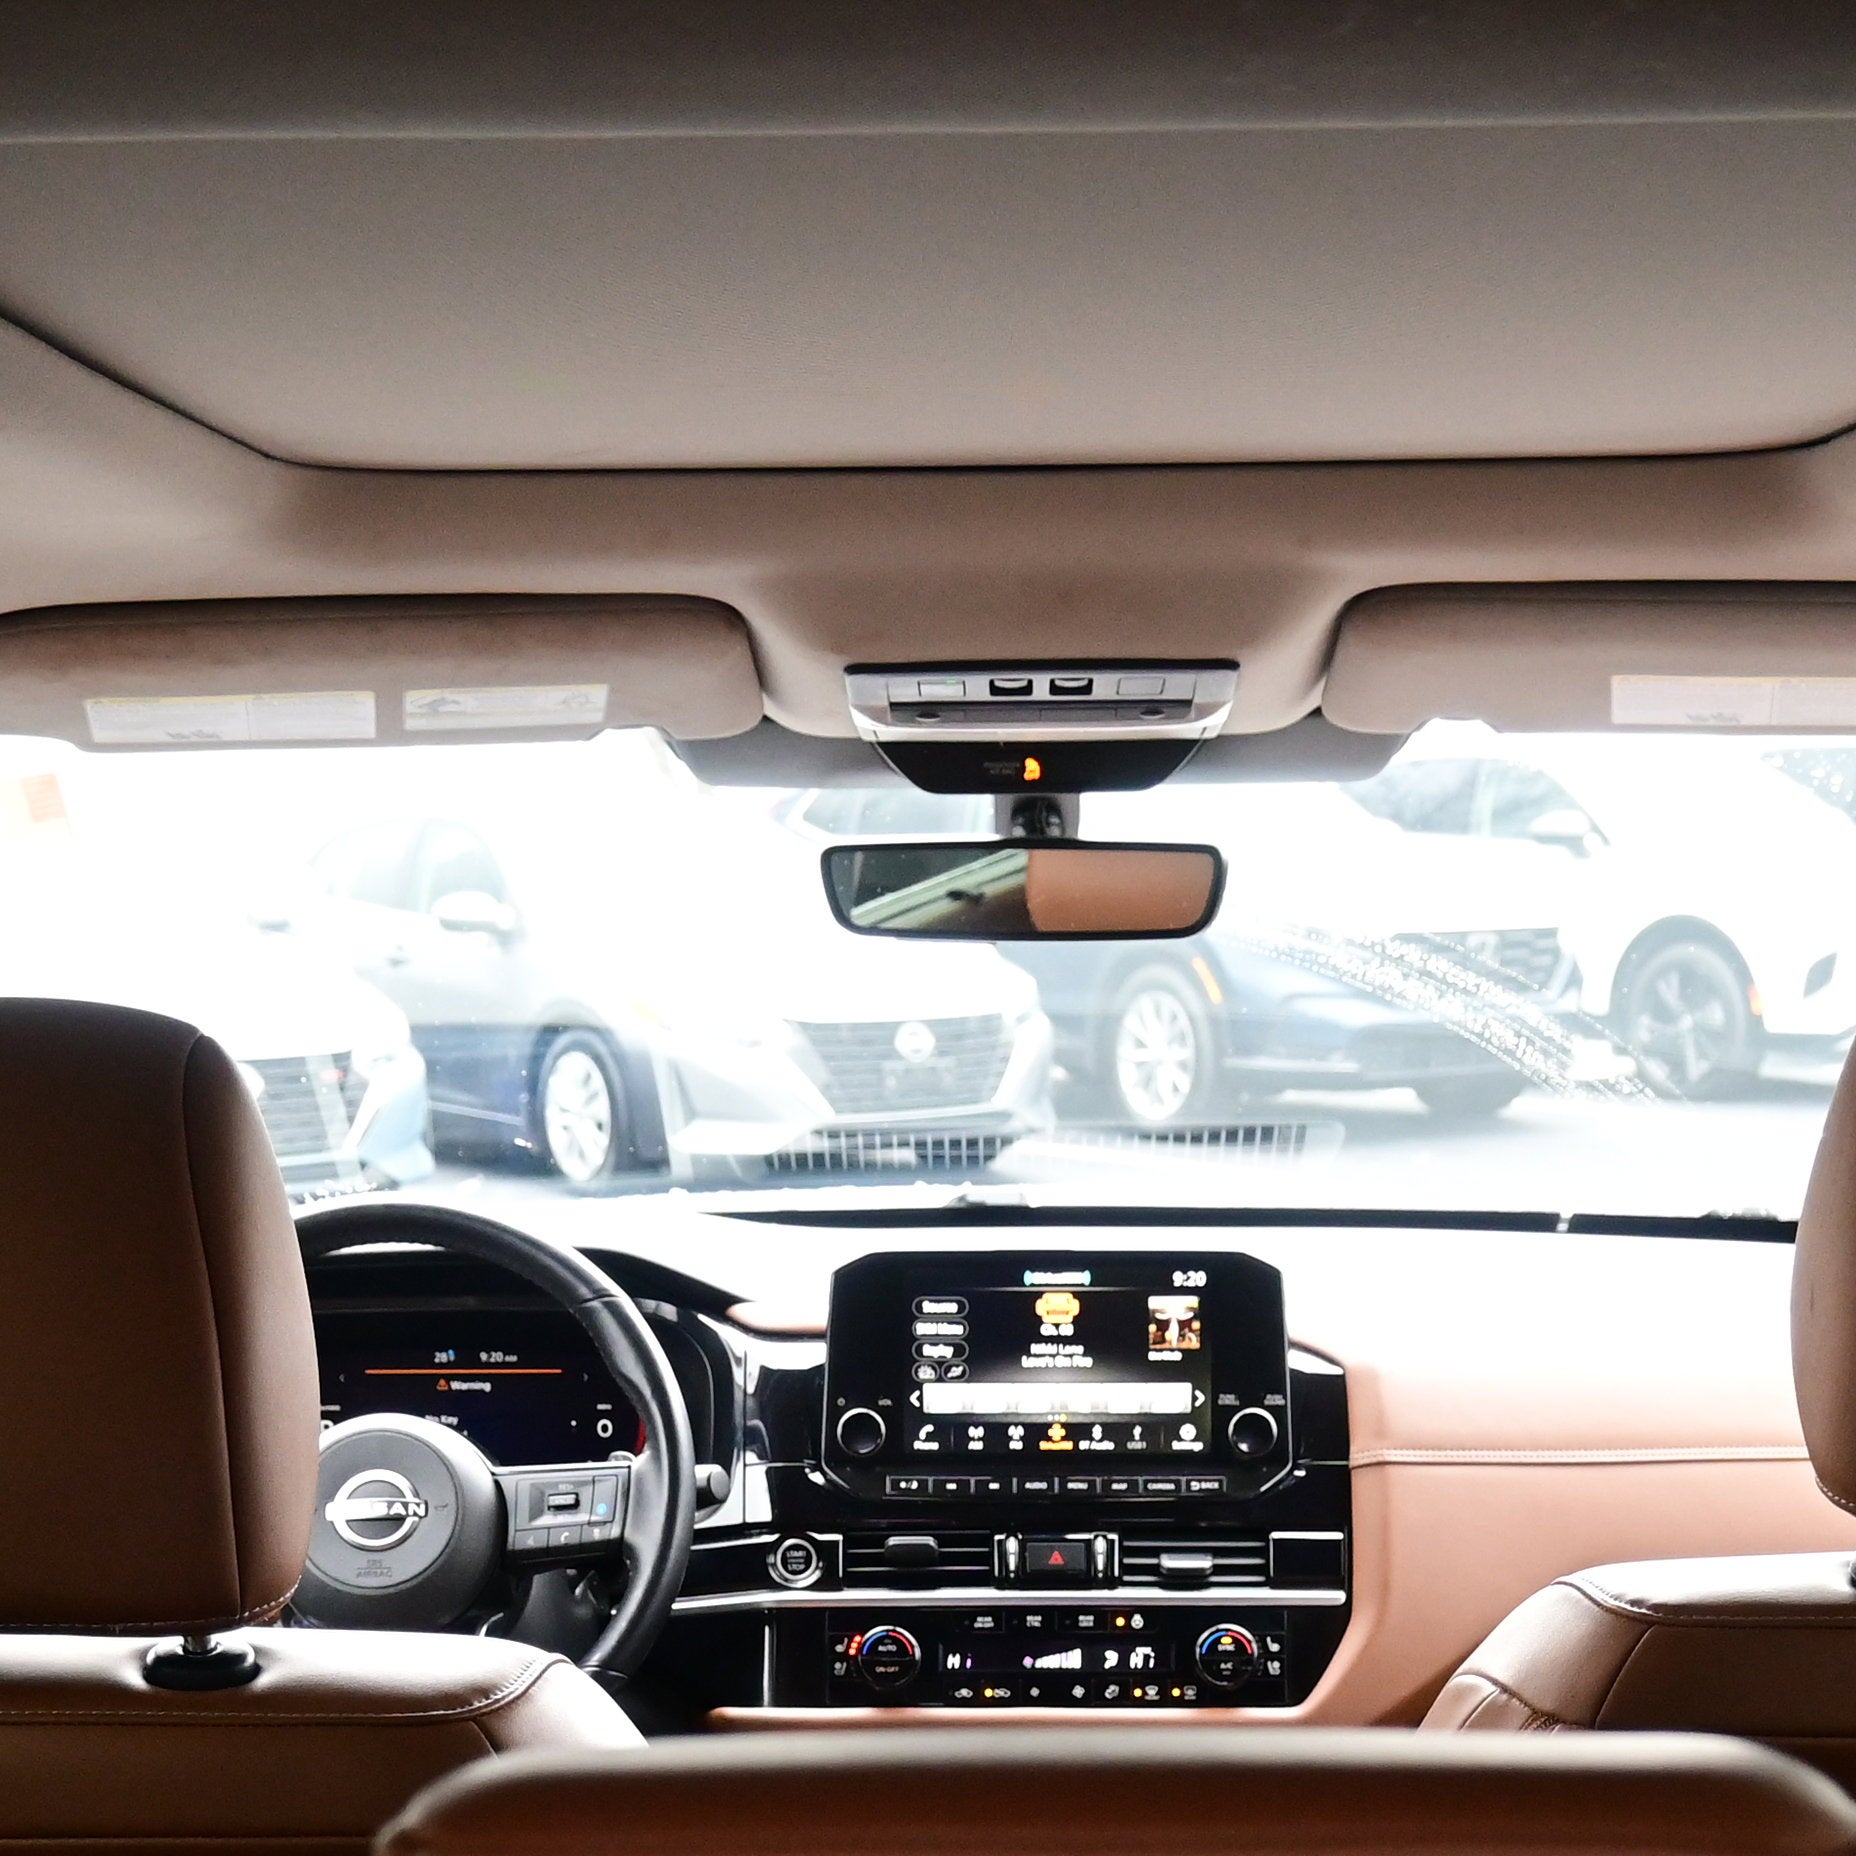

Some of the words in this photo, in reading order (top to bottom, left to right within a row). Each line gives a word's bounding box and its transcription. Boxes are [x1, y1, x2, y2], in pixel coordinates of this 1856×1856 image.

[1172, 1270, 1207, 1288] 9:20
[479, 1351, 504, 1363] 9:20
[449, 1380, 492, 1393] Warning
[1200, 1481, 1220, 1490] BACK
